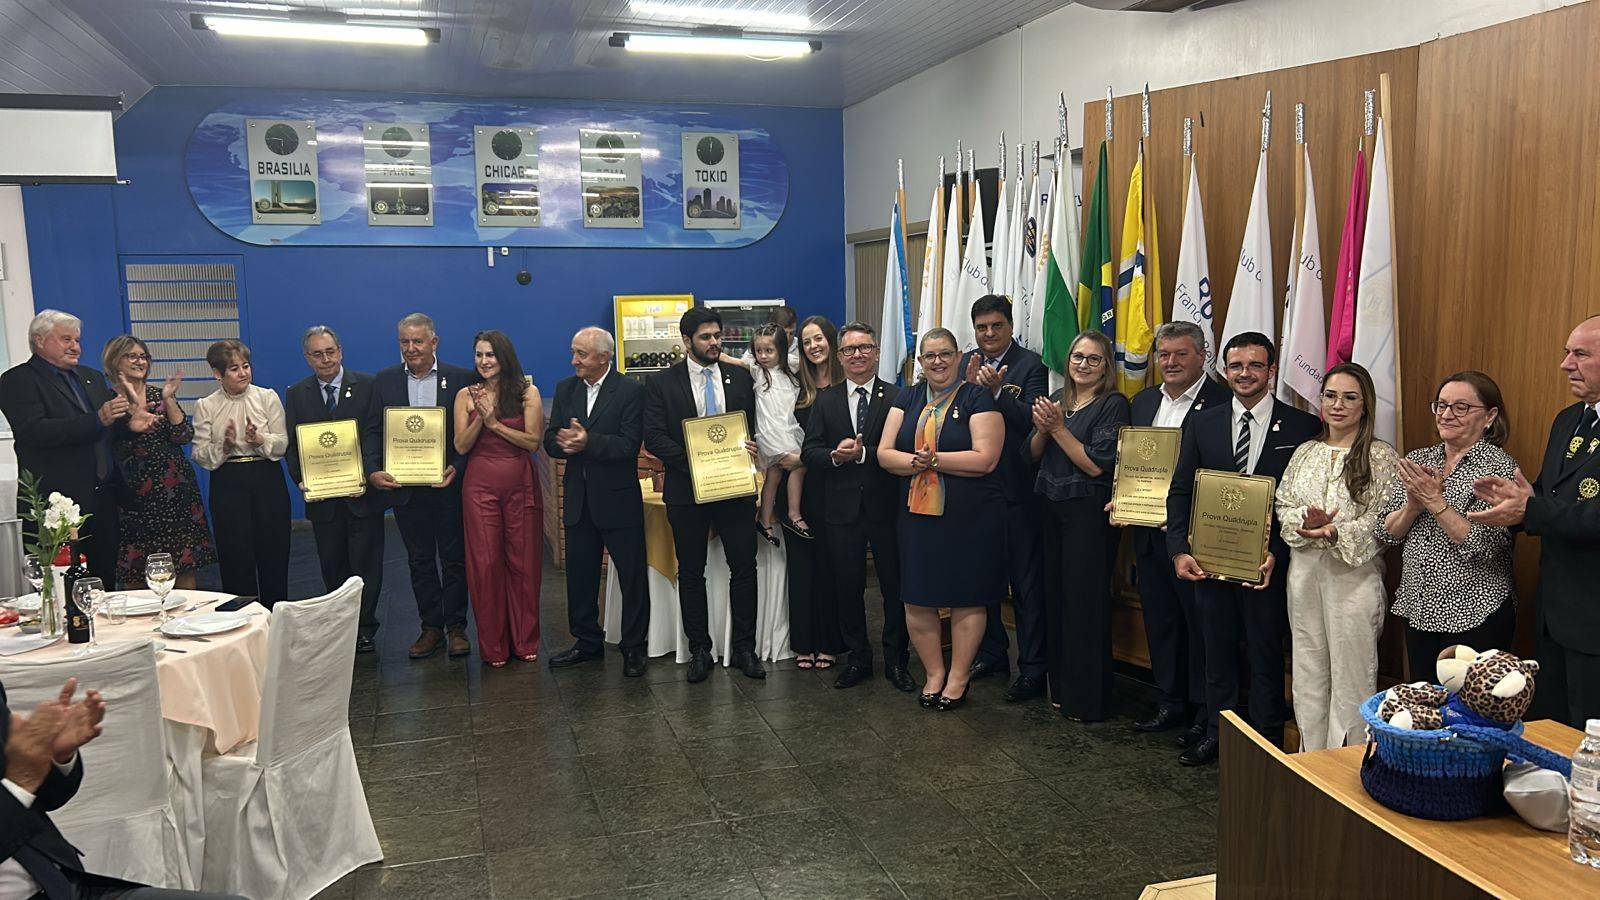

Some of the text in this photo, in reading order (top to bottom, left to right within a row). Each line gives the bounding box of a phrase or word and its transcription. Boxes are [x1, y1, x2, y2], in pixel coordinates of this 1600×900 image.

[257, 161, 311, 176] BRASILIA
[695, 169, 728, 183] TOKIO
[964, 256, 981, 279] lub
[1240, 248, 1256, 273] lub
[1201, 511, 1221, 520] Prova
